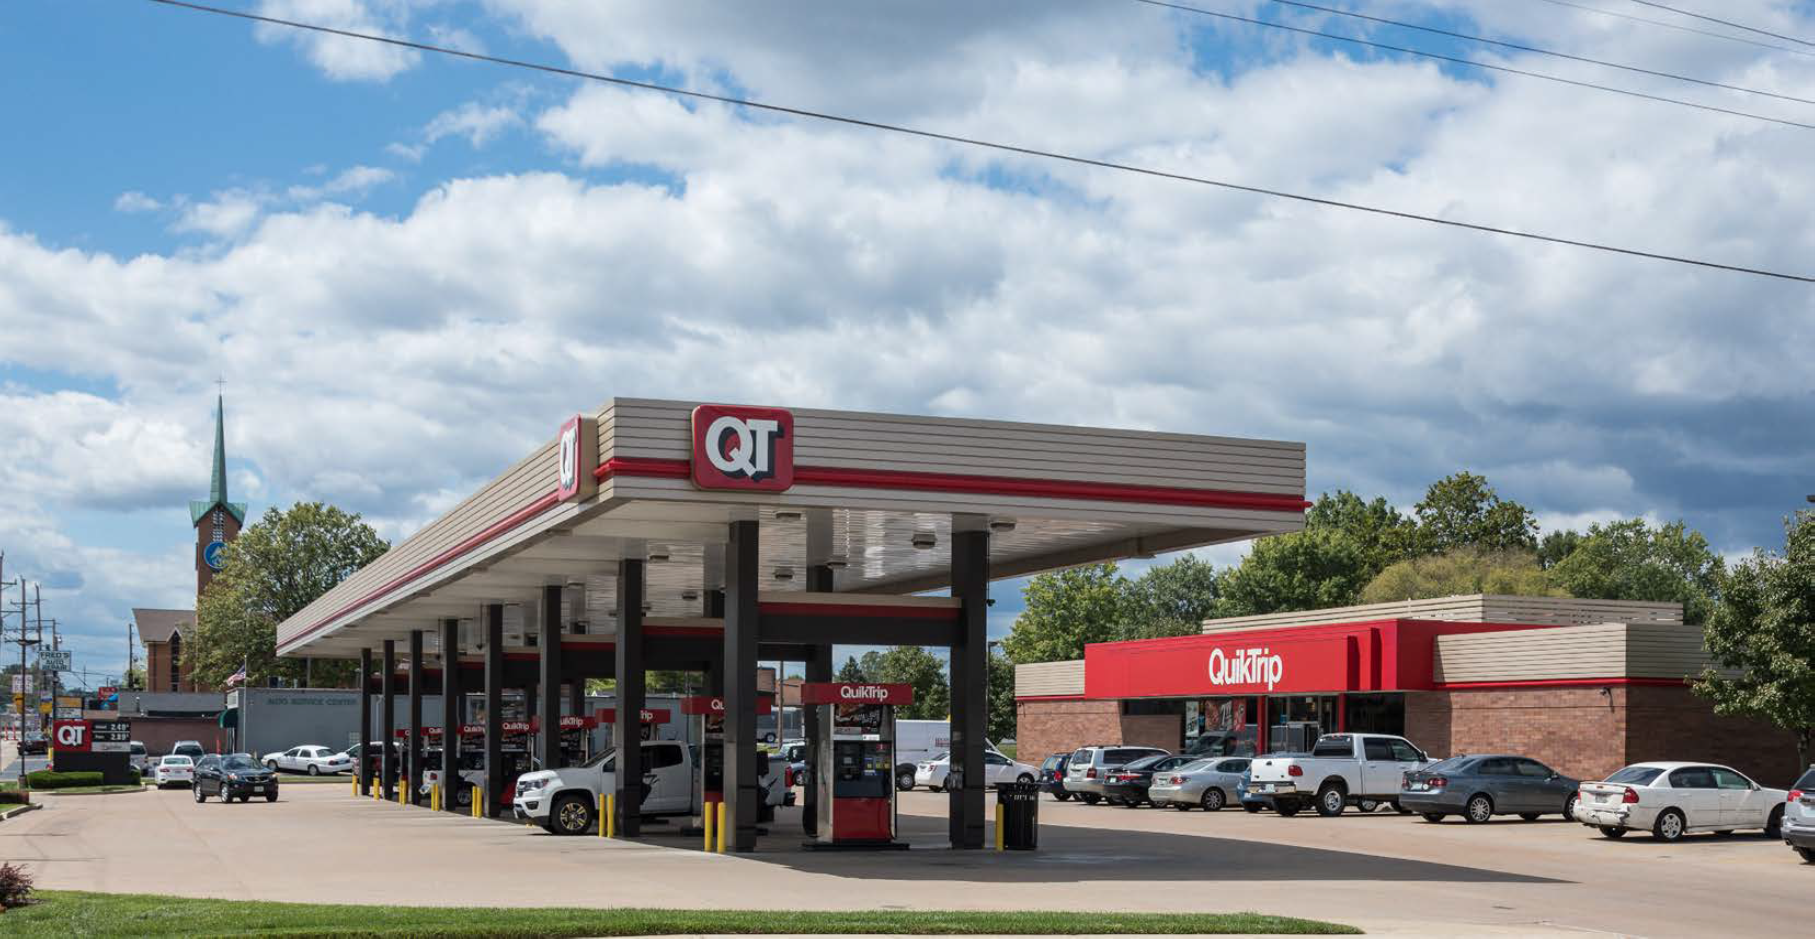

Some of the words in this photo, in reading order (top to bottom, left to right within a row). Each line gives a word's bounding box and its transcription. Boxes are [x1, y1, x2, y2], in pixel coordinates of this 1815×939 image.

[560, 426, 577, 485] QT
[705, 416, 779, 477] QT
[1209, 647, 1283, 691] QuikTrip
[840, 685, 888, 702] QuikTrip
[503, 722, 530, 731] QuikTrip
[560, 717, 584, 727] uikTrip
[58, 725, 86, 746] QT
